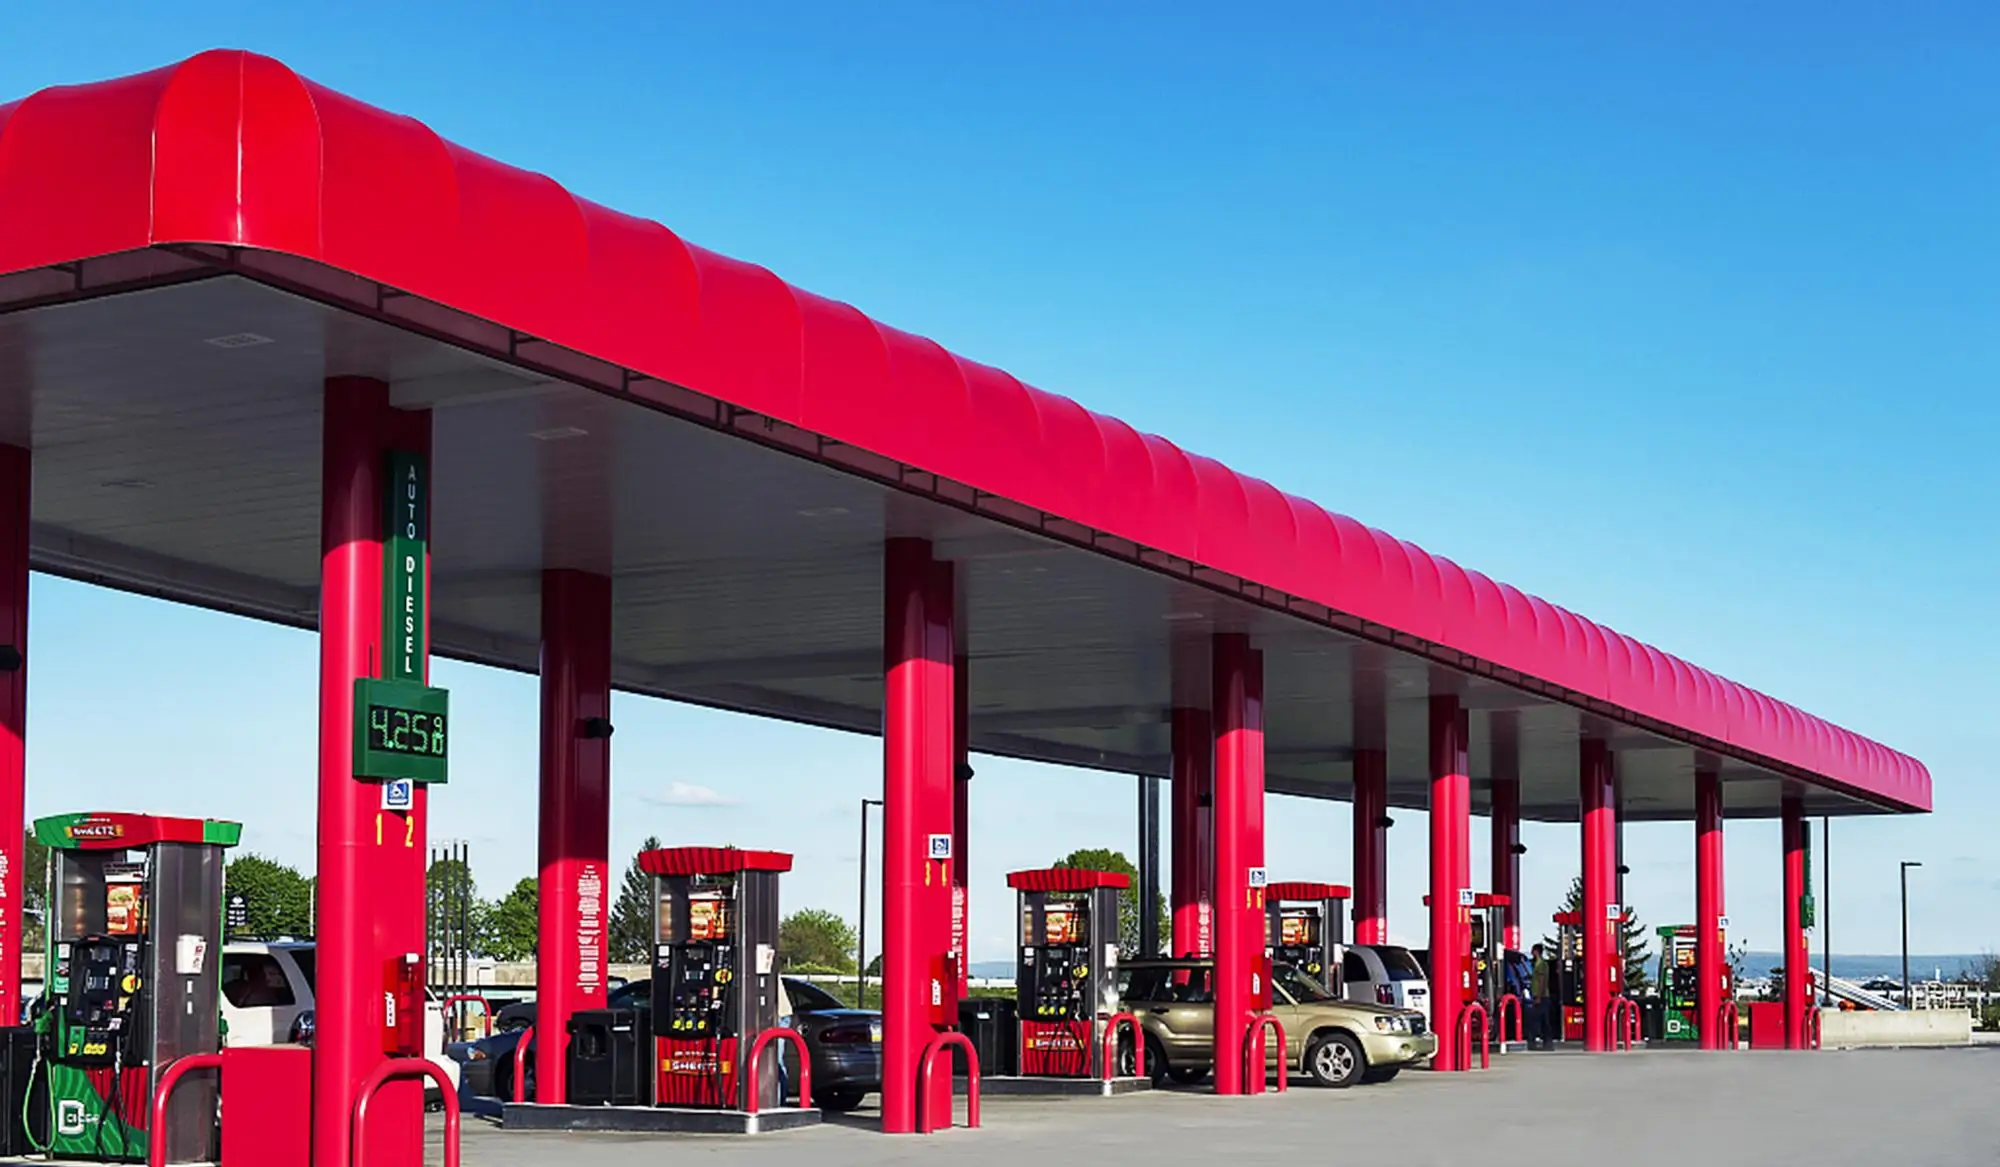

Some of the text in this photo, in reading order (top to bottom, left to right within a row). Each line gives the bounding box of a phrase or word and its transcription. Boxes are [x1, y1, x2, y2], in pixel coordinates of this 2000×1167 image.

[407, 464, 417, 540] AUTO
[404, 555, 416, 673] DIESEL
[376, 813, 414, 848] 1 2
[671, 1059, 718, 1073] SHEE
